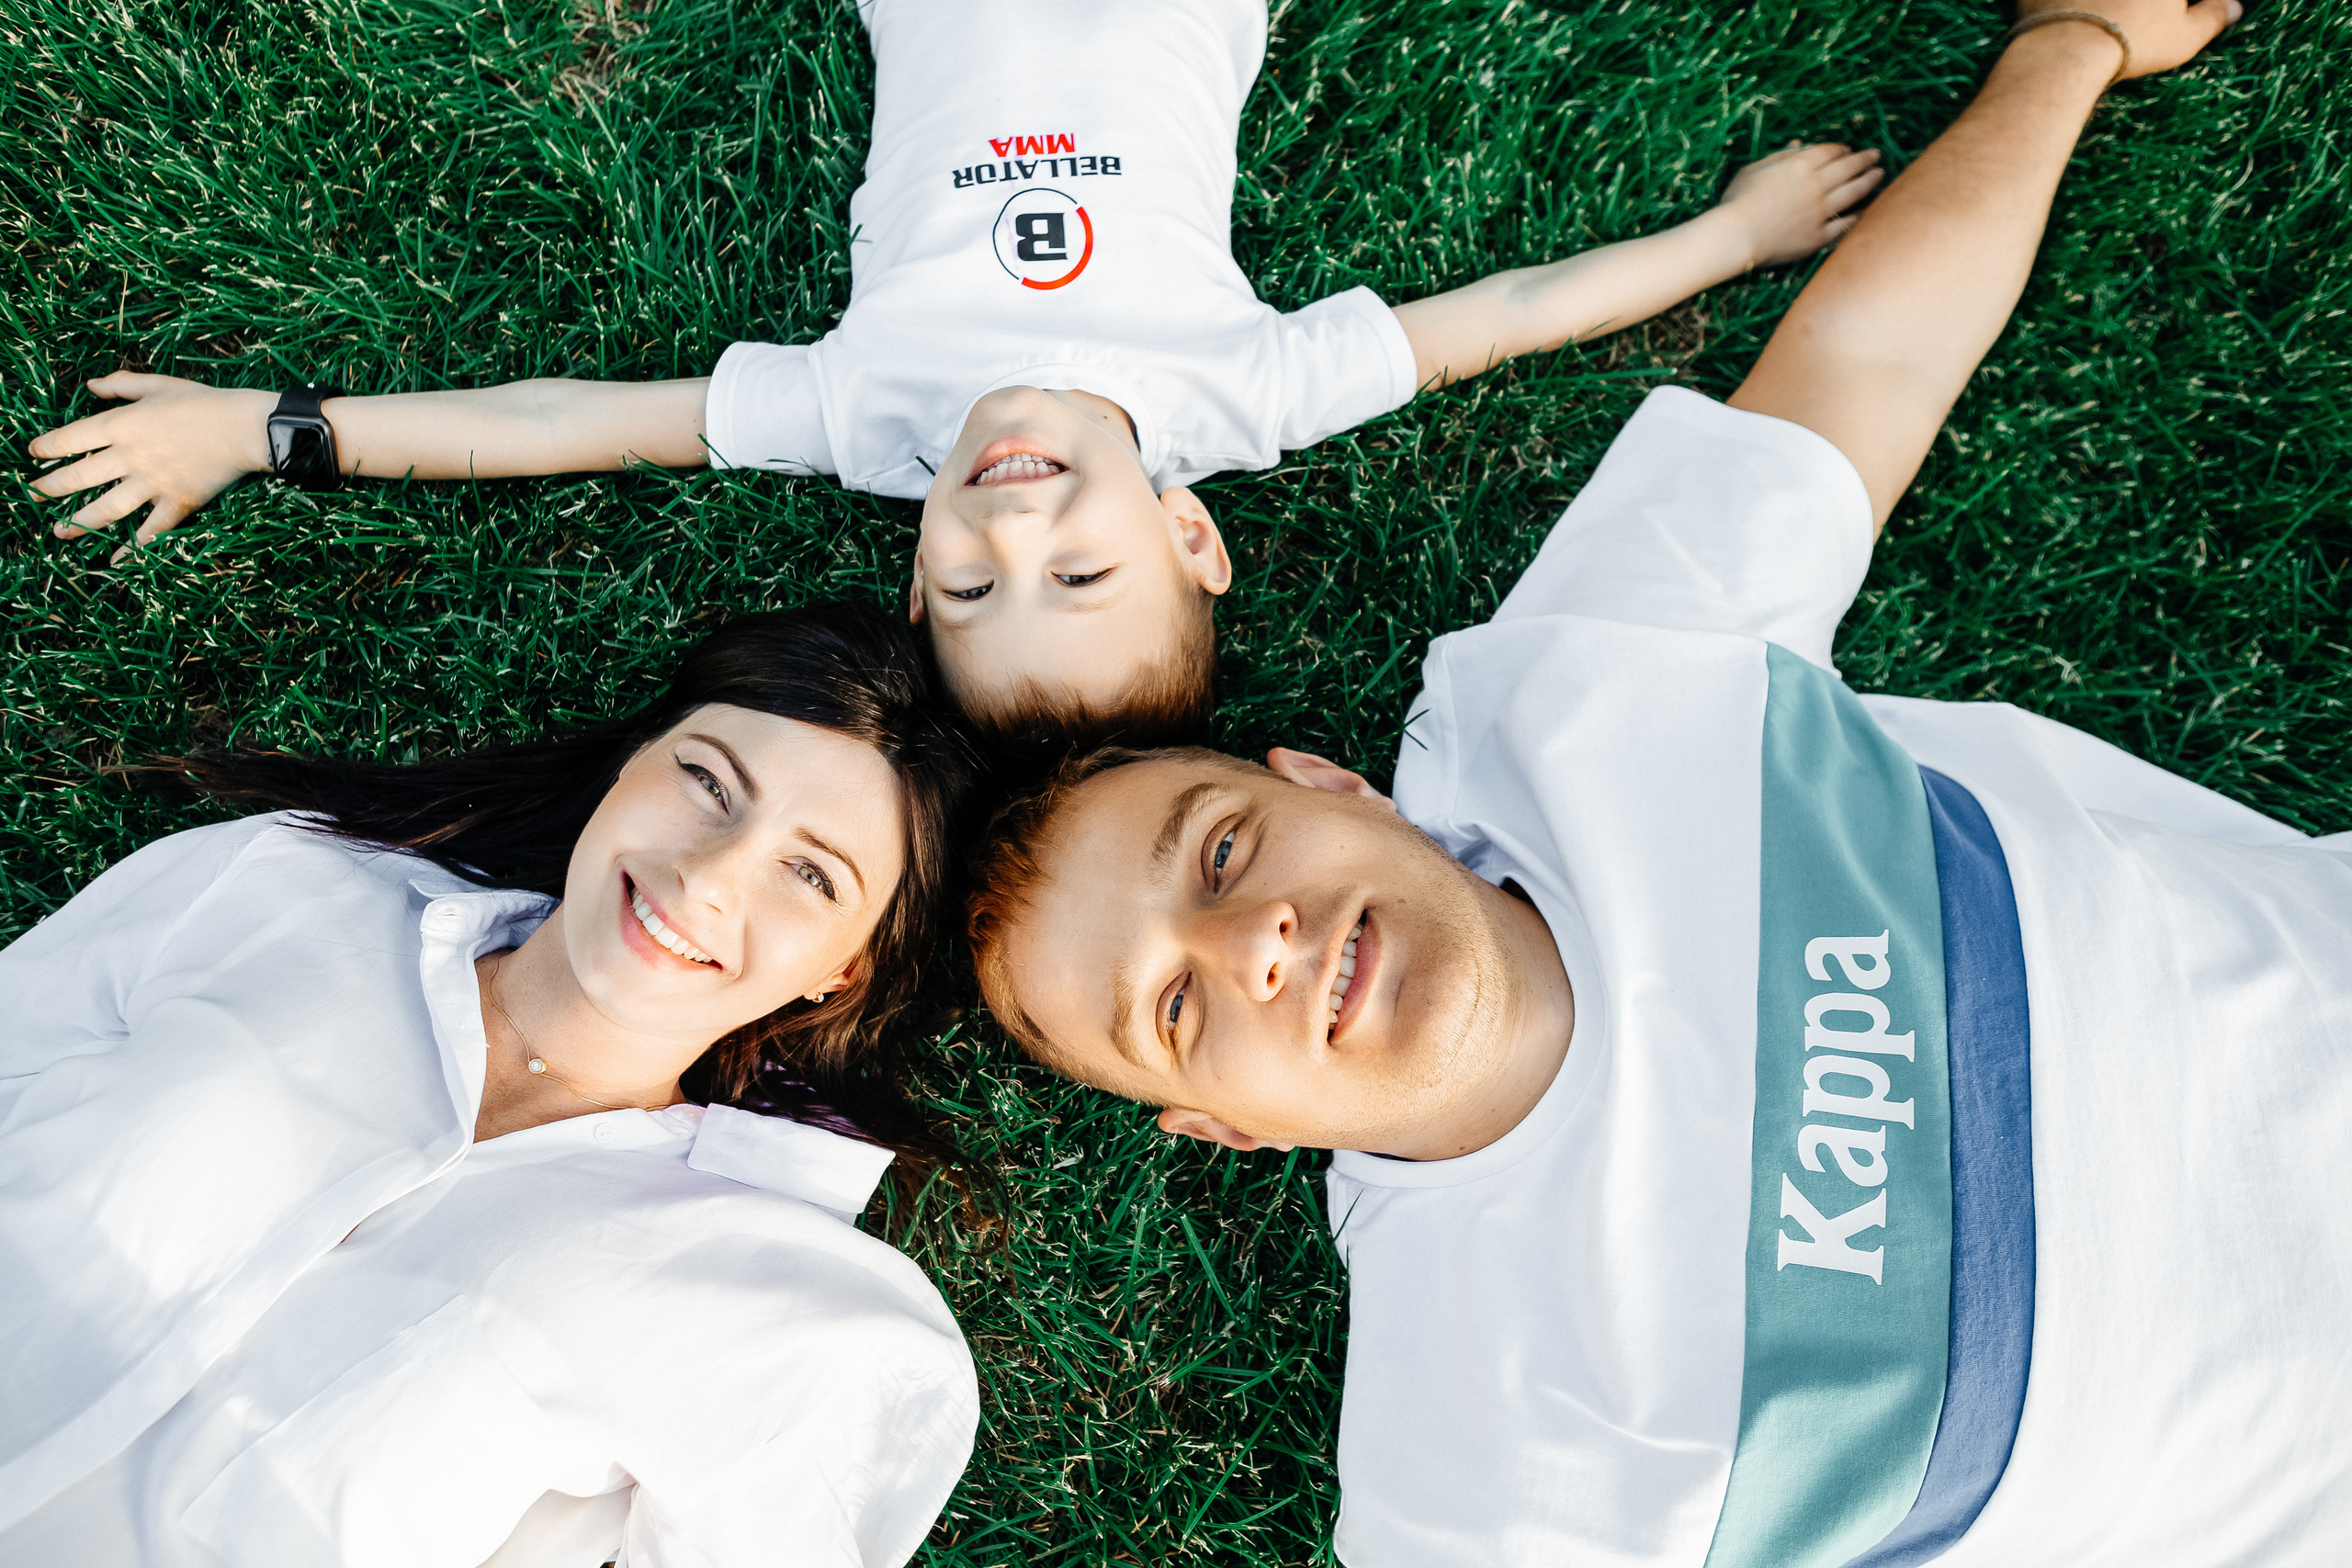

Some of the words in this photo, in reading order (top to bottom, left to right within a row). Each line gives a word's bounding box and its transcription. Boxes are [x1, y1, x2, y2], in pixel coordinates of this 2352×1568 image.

[989, 133, 1075, 157] MMA
[952, 156, 1122, 188] BELLATOR
[1015, 212, 1069, 262] B
[1777, 929, 1915, 1285] Kappa
